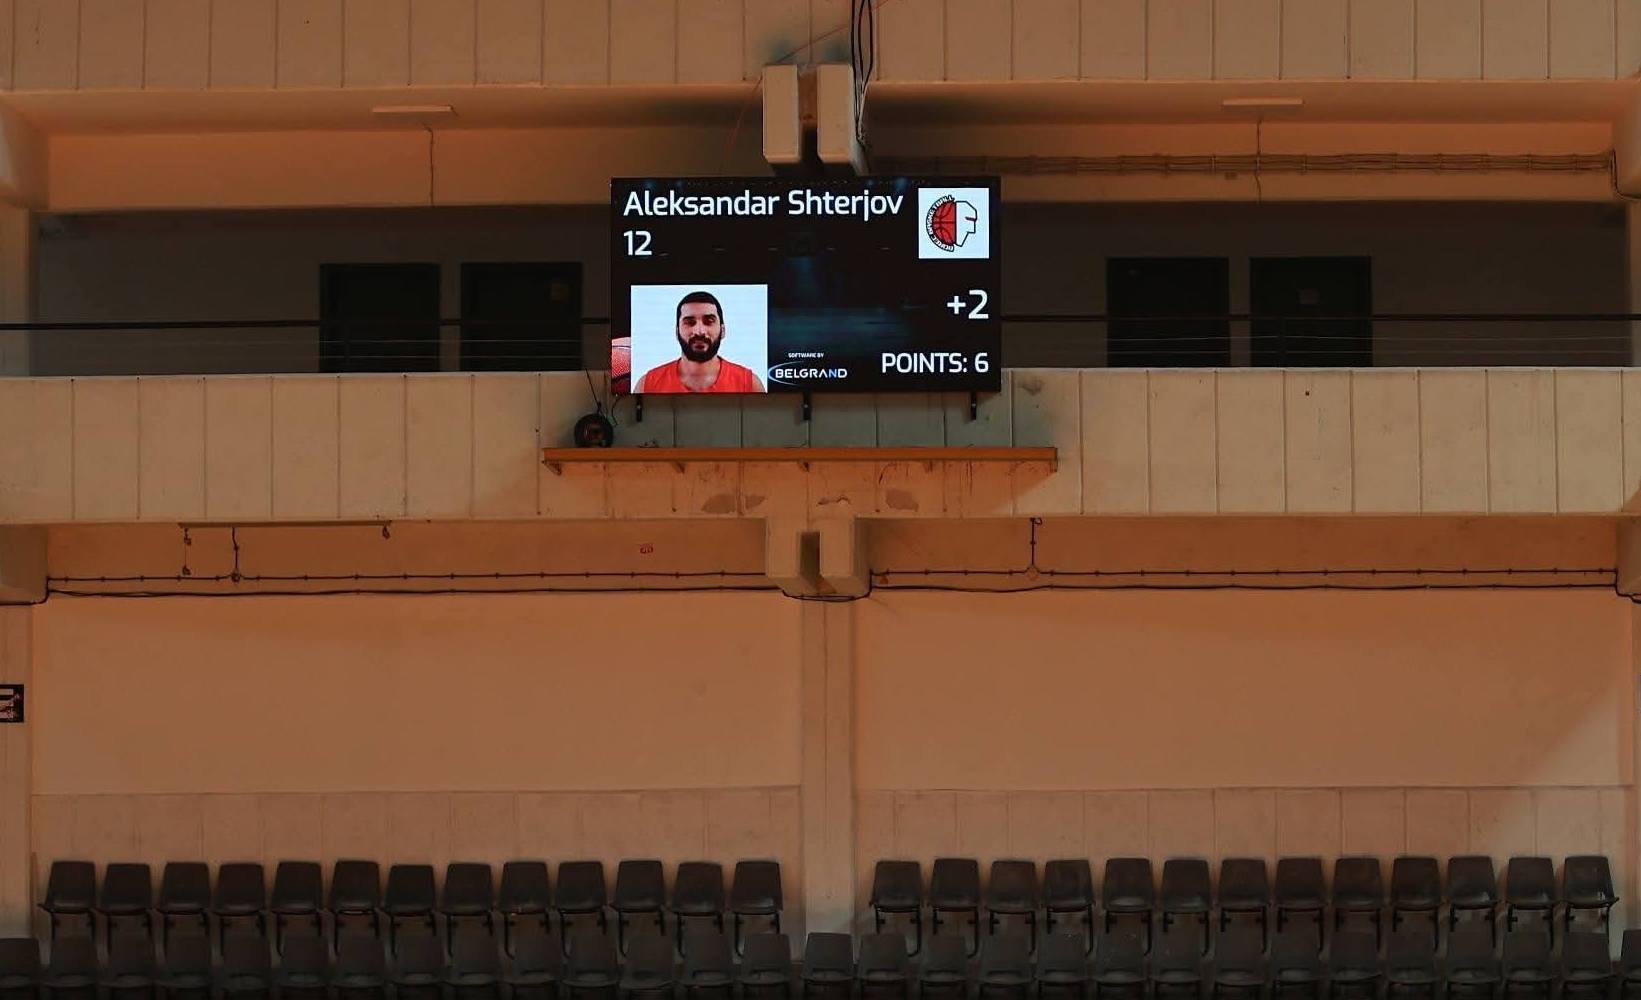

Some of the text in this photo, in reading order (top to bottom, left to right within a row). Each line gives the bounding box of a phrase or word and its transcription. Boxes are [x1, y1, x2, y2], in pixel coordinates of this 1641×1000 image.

[623, 188, 904, 222] Aleksandar Shterjov
[623, 230, 653, 256] 12
[946, 289, 989, 320] +2
[775, 368, 848, 379] BELGRAND
[881, 352, 989, 374] POINTS: 6
